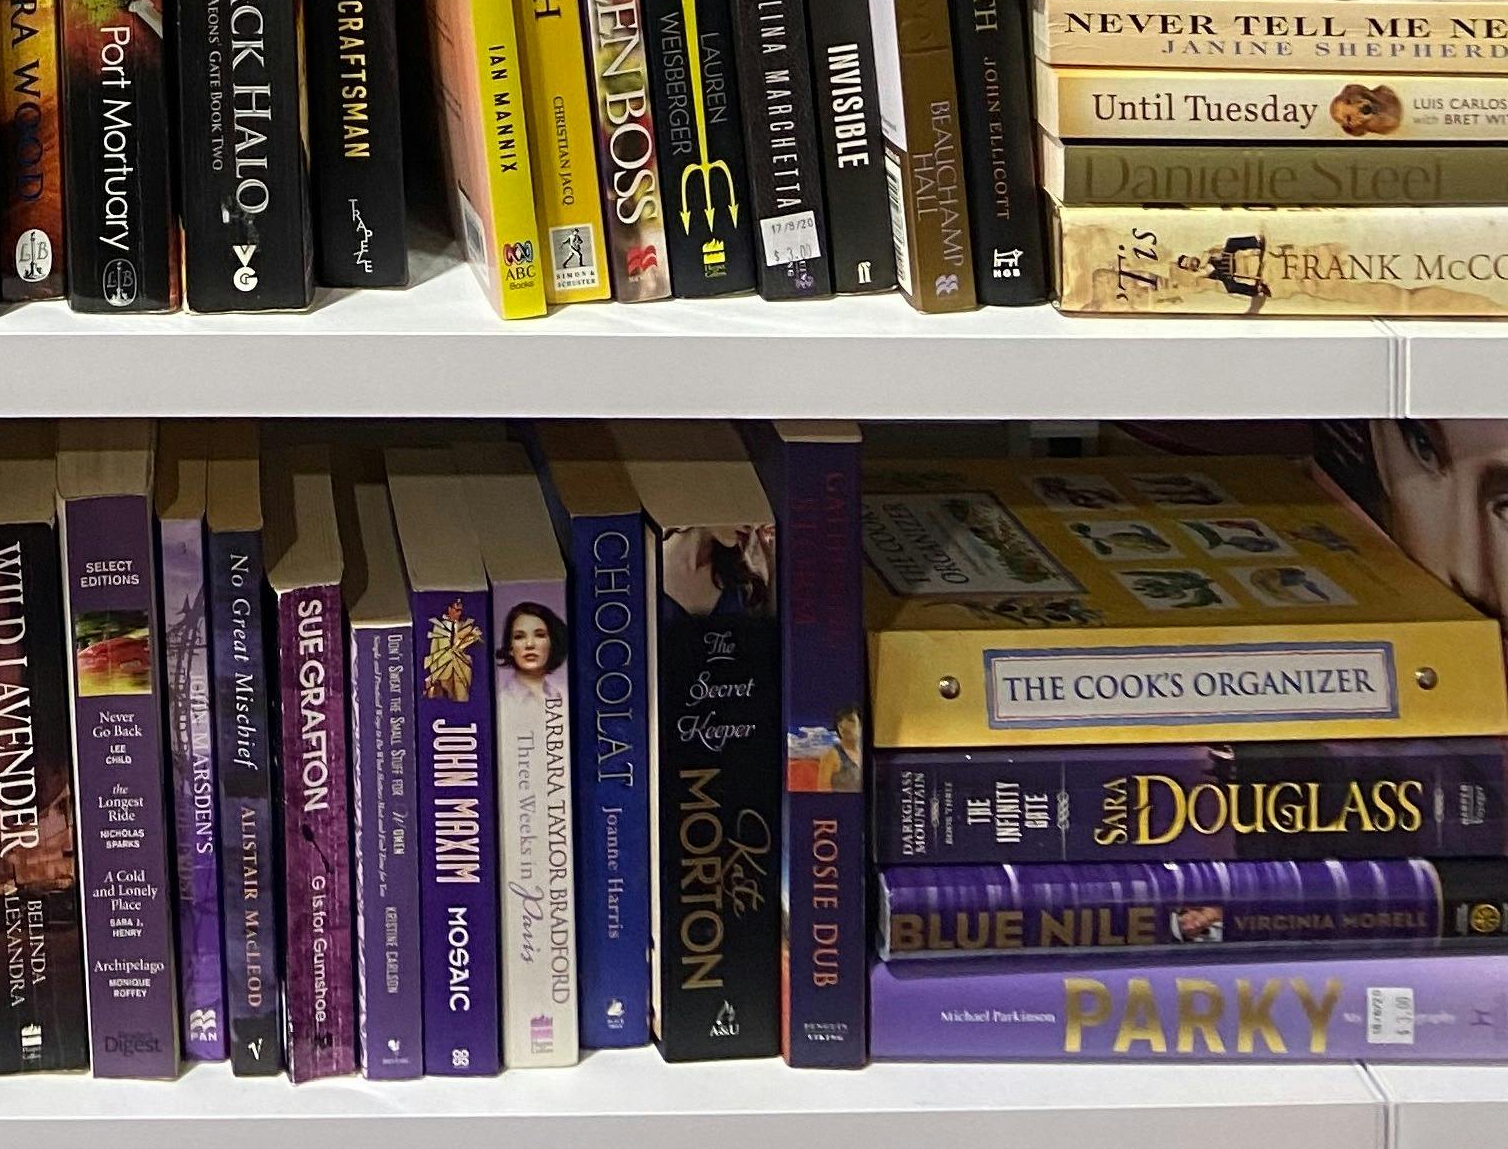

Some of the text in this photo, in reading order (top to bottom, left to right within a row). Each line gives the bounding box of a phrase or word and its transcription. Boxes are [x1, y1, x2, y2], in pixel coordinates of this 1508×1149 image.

[1064, 12, 1431, 39] NEVER TELL ME
[99, 26, 133, 251] Port Mortuary
[1092, 93, 1318, 130] Until Tuesday
[232, 82, 271, 214] HALO
[80, 573, 140, 589] EDITIONS
[85, 560, 133, 575] SELECT
[593, 532, 636, 787] CHOCOLAT
[686, 672, 755, 707] Secret
[1003, 667, 1378, 702] THE COOK'S ORGANIZER
[297, 599, 329, 813] SUE GRAFTON
[677, 711, 756, 751] Keeper
[434, 798, 481, 885] MAXIM
[1094, 778, 1128, 845] SARA
[1132, 774, 1423, 846] DOUGLASS
[678, 768, 725, 990] MORTON
[812, 819, 838, 988] ROSIE DUB
[447, 907, 470, 1012] MOSAIC
[891, 907, 1156, 951] BLUE NILE
[1062, 978, 1343, 1053] PARKY
